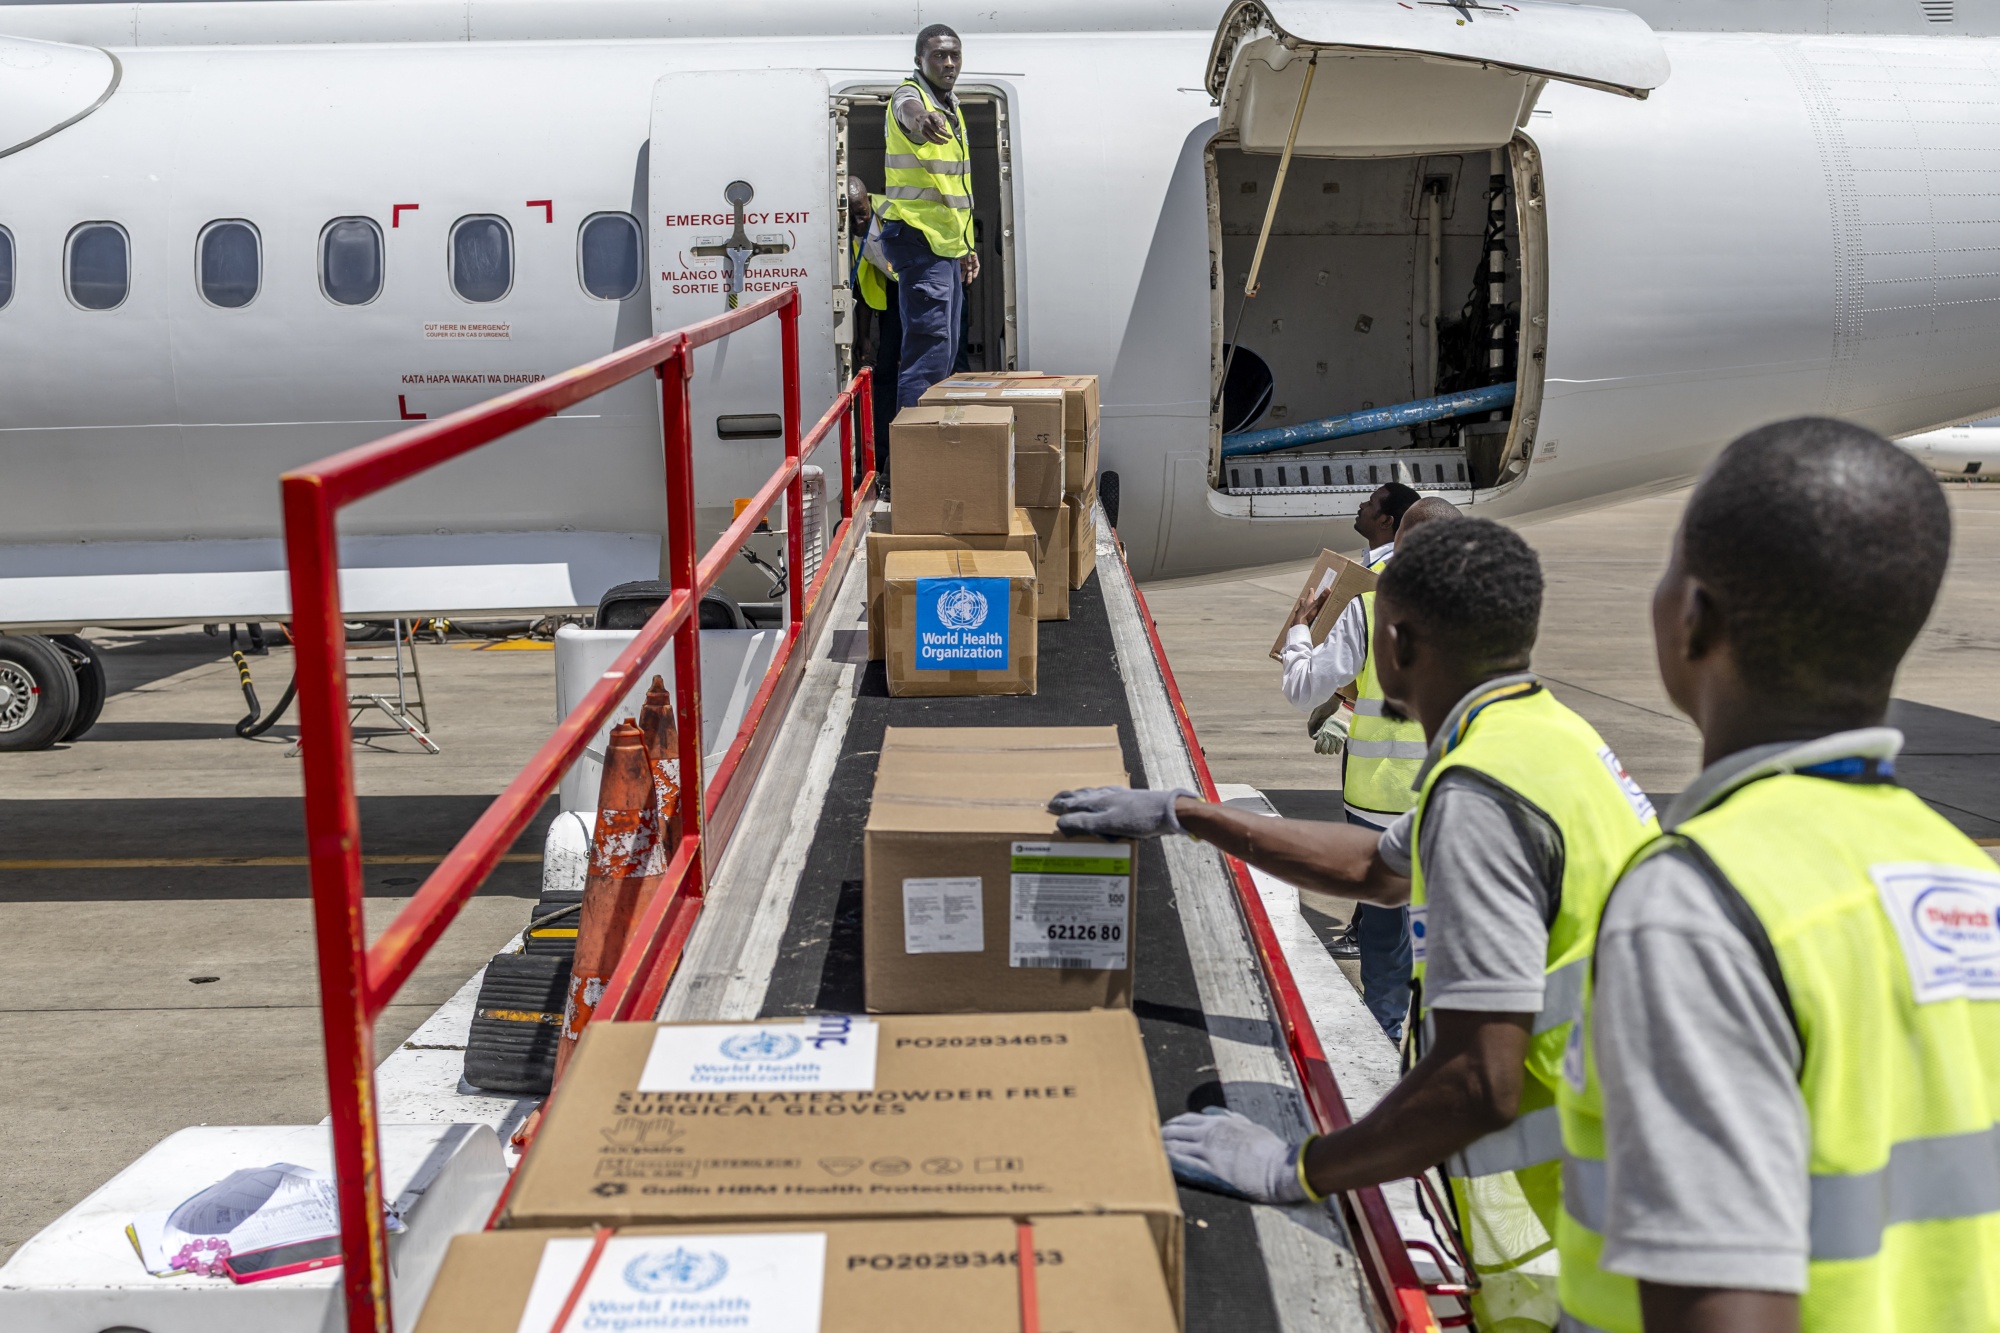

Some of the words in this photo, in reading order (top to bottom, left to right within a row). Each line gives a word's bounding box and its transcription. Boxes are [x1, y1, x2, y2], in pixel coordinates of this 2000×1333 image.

[666, 212, 770, 226] EMERGECY
[774, 212, 810, 224] EXIT
[661, 270, 717, 281] MLANGO
[745, 268, 808, 279] DHARURA
[672, 283, 719, 294] SORTIE
[401, 374, 425, 384] KATA
[426, 374, 451, 384] HAPA
[451, 374, 485, 384] WAKATI
[487, 374, 501, 384] WA
[503, 374, 546, 384] DHARURA
[922, 632, 958, 645] World
[962, 632, 1002, 645] Health
[922, 646, 1002, 661] Organization
[1048, 925, 1097, 940] 62126
[1101, 925, 1121, 940] 80
[895, 1034, 1068, 1049] PO202934653
[693, 1063, 750, 1073] World
[758, 1062, 821, 1073] Health
[690, 1073, 820, 1084] Organization
[618, 1091, 739, 1103] STERILE
[752, 1091, 845, 1103] LATEX
[857, 1089, 994, 1102] POWDER
[1005, 1086, 1078, 1099] FREE
[612, 1103, 773, 1116] SURGICAL
[784, 1103, 907, 1116] GLOVES
[784, 1182, 863, 1196] Health
[588, 1299, 662, 1313] World
[670, 1297, 752, 1312] Health
[582, 1314, 750, 1332] Organization
